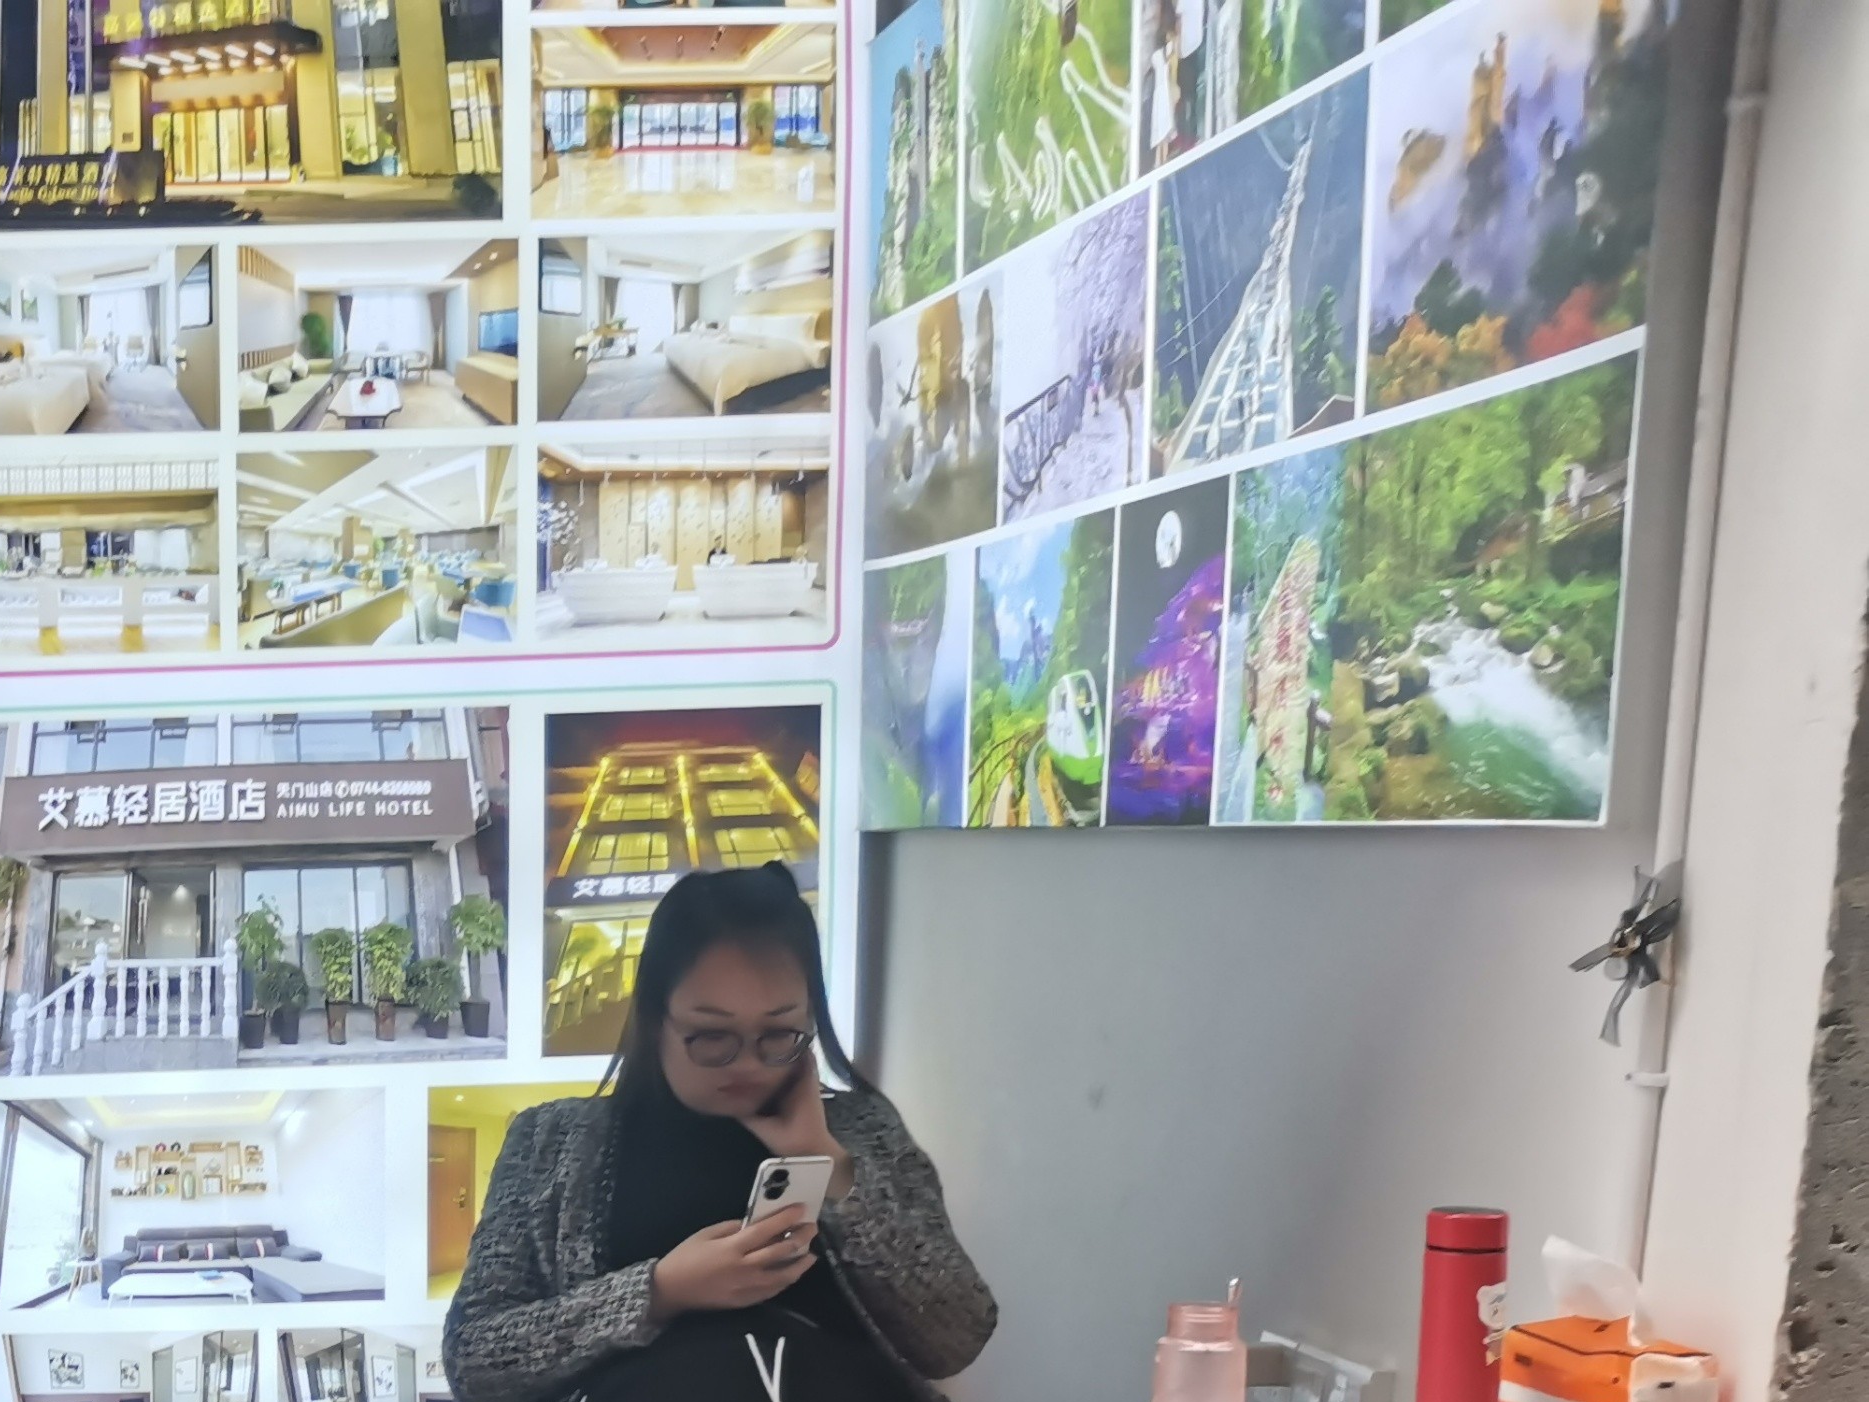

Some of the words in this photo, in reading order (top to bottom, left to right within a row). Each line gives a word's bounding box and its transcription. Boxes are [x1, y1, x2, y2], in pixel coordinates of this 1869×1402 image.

[38, 778, 266, 831] 艾慕轻居酒店
[276, 802, 320, 819] AIMU
[328, 801, 366, 817] LIFE
[375, 800, 434, 816] HOTEL
